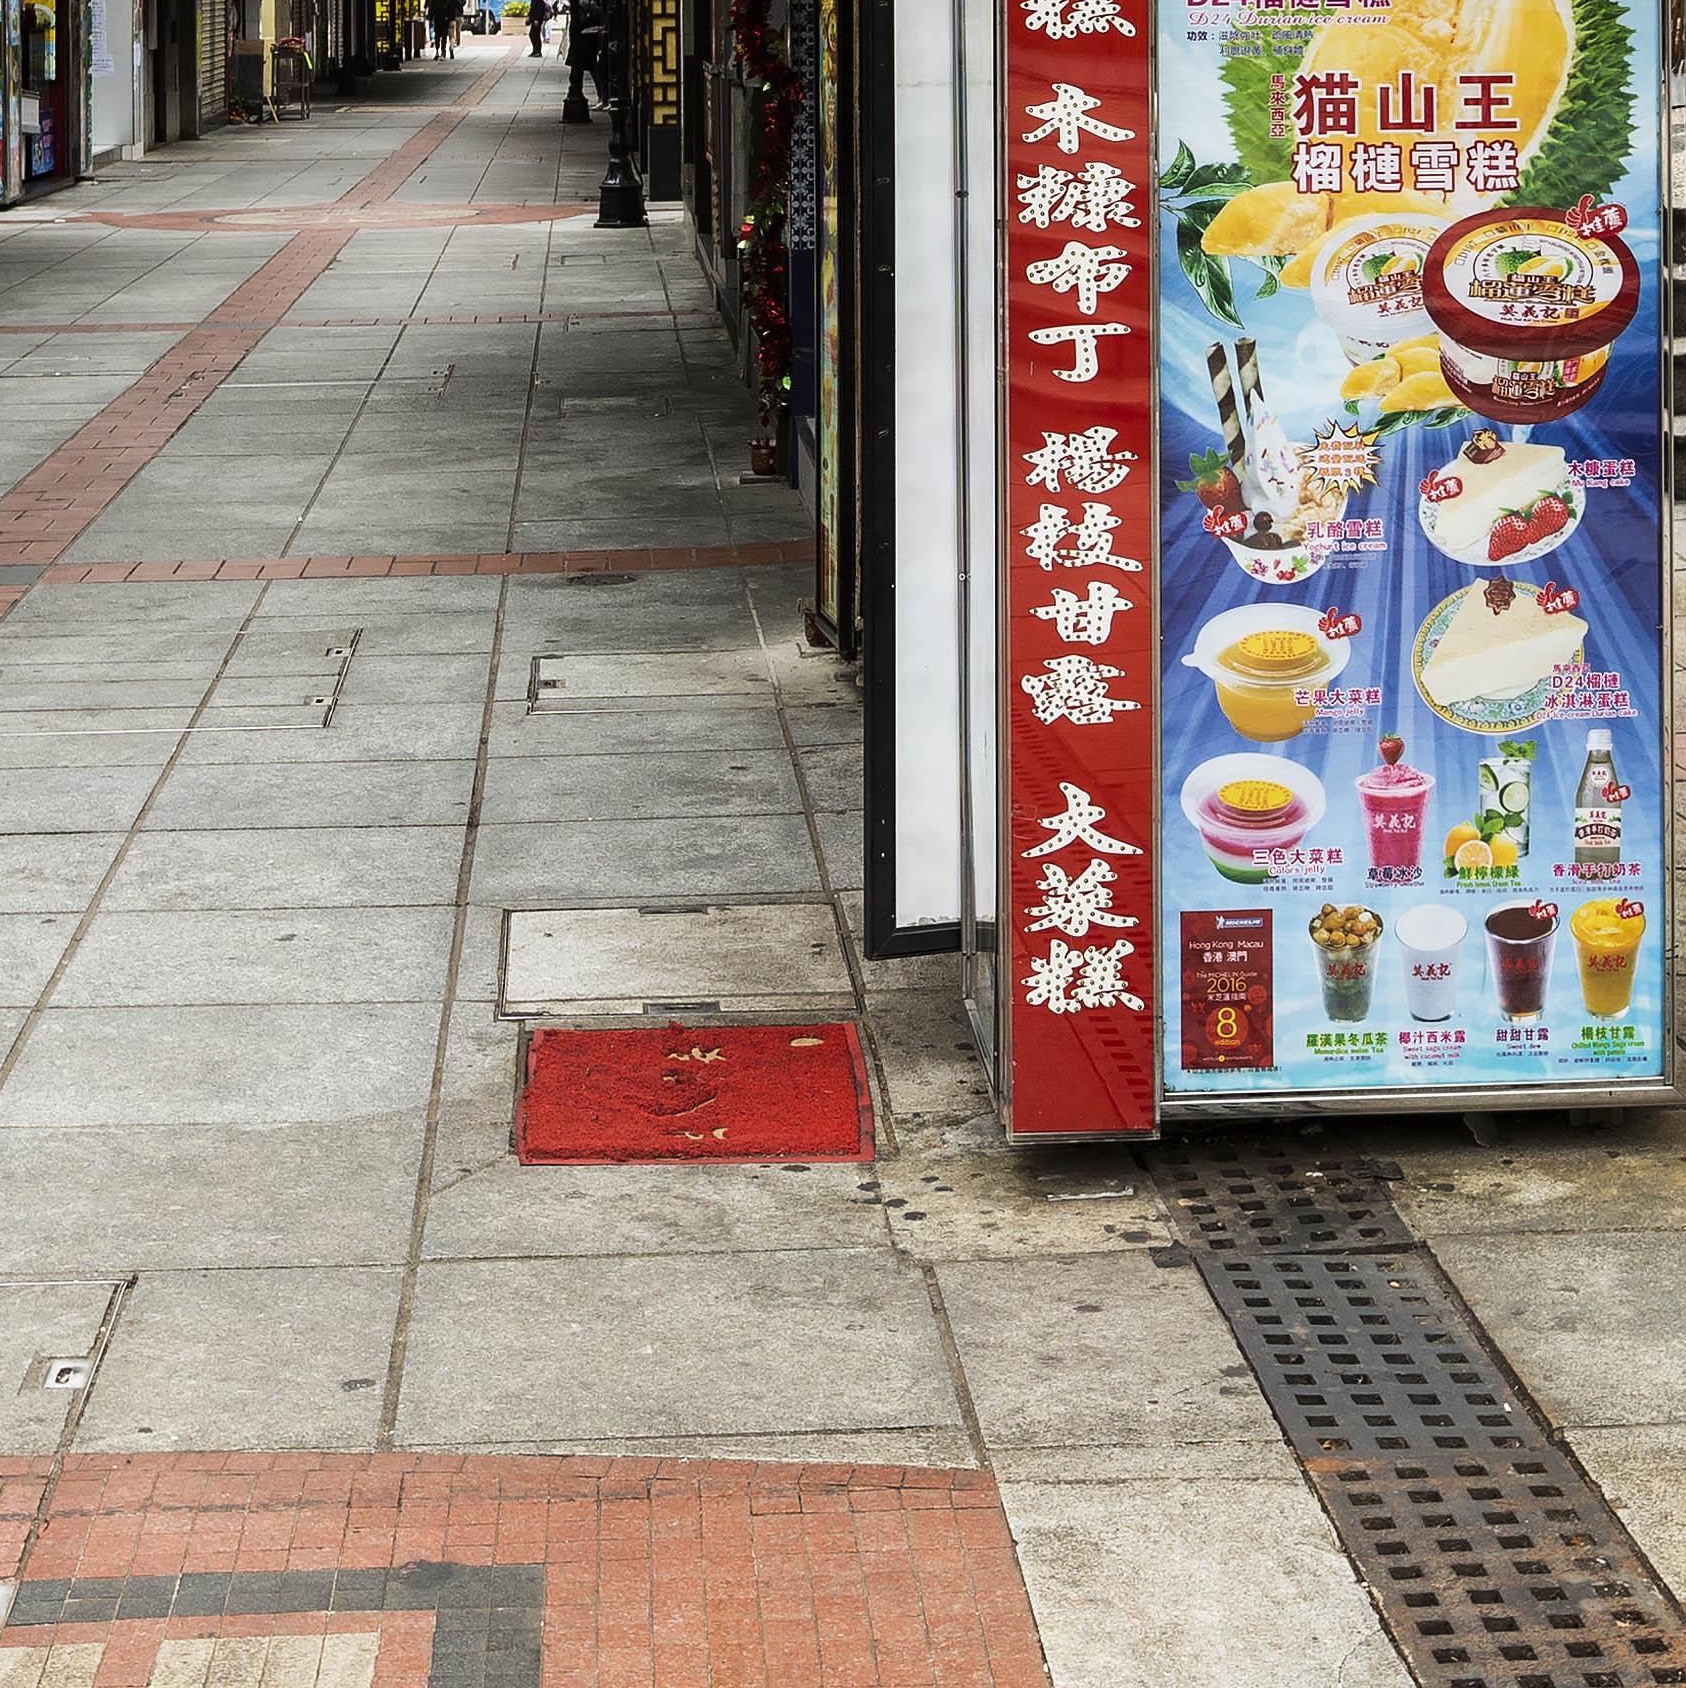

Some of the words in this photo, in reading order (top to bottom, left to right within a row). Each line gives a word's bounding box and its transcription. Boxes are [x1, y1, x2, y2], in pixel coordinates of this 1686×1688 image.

[1270, 73, 1287, 138] 馬來西亞
[1294, 72, 1519, 135] 猫山王
[1291, 141, 1520, 193] 榴槤雪糕
[1016, 82, 1143, 385] 木糠布丁
[1567, 459, 1636, 477] 木糠蛋糕
[1307, 519, 1382, 540] 乳酪雪糕
[1019, 427, 1145, 727] 楊枝甘露
[1294, 688, 1381, 707] 芒果大菜糕
[1252, 847, 1344, 867] 三色大菜糕
[1019, 781, 1145, 1015] 大菜糕
[1207, 978, 1247, 993] 2016
[1217, 1007, 1237, 1038] 8
[1495, 1027, 1550, 1042] 甜甜甘露
